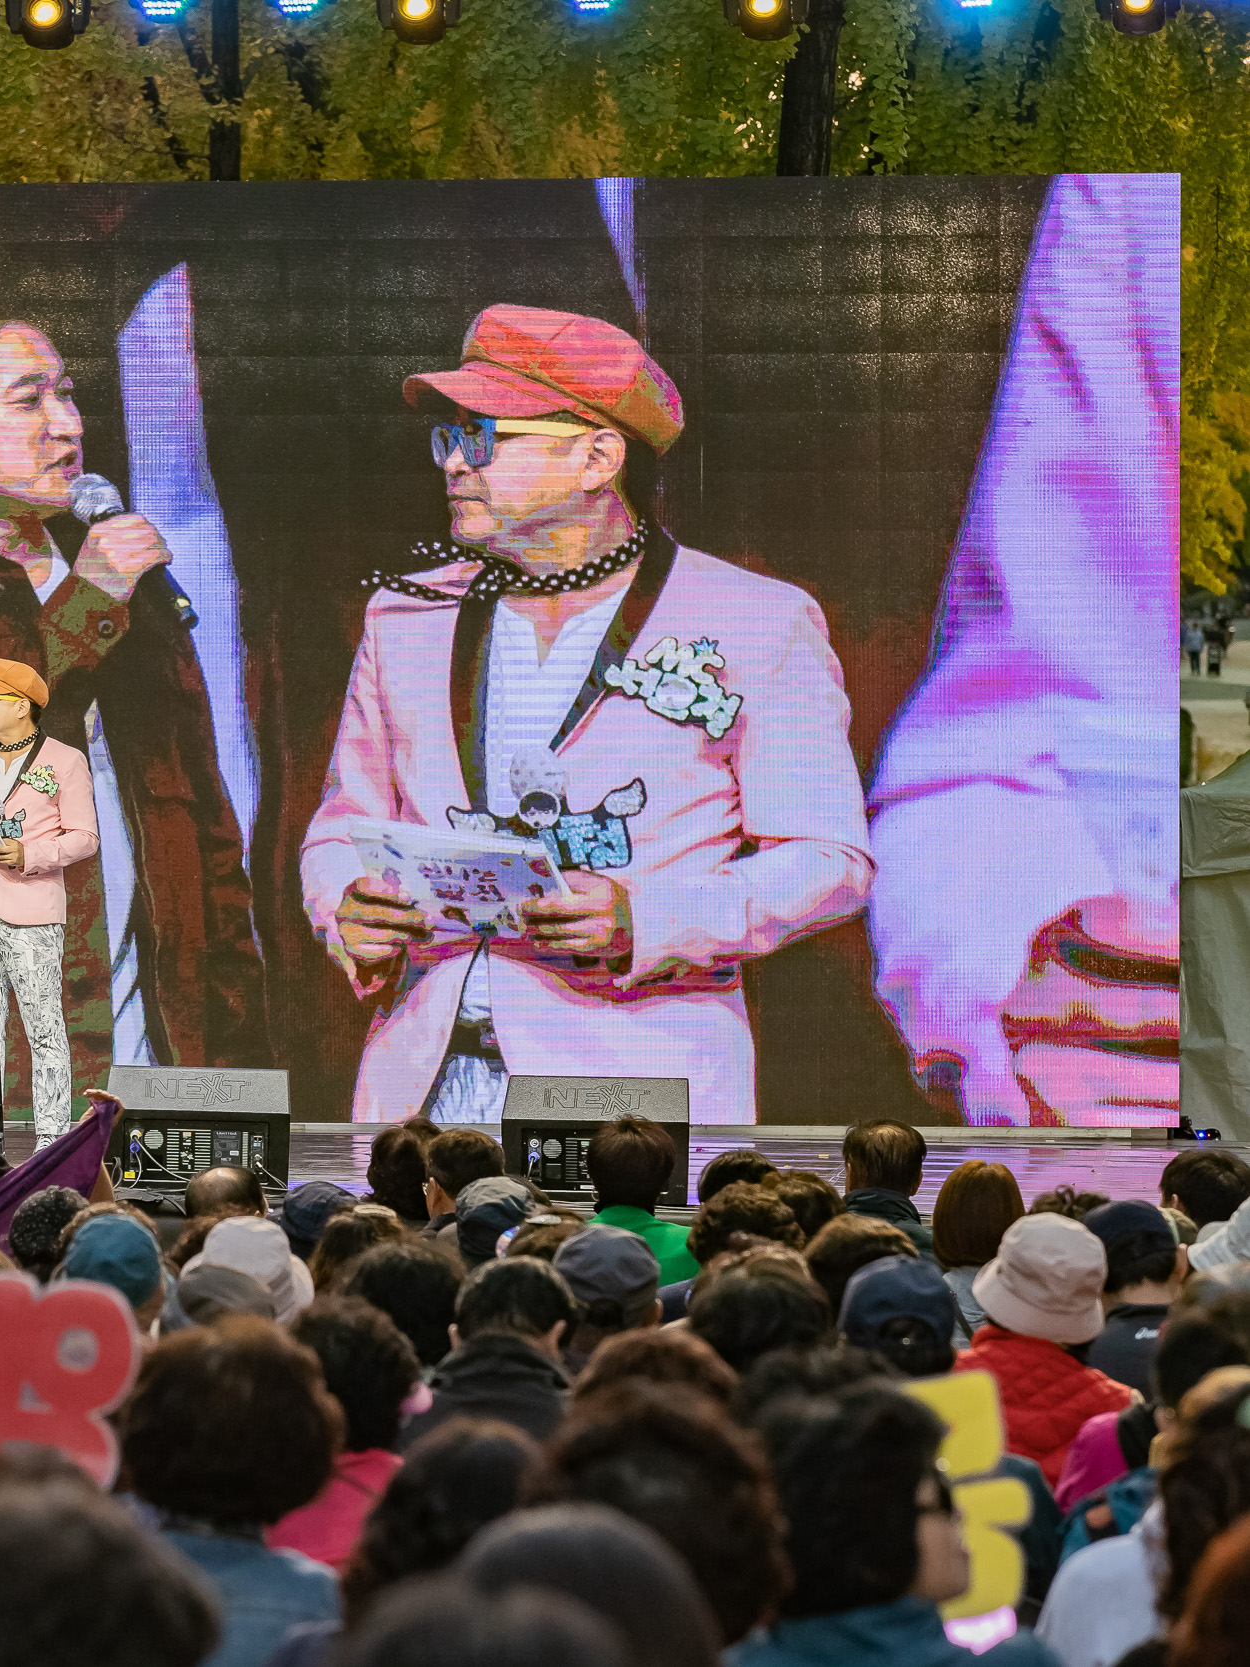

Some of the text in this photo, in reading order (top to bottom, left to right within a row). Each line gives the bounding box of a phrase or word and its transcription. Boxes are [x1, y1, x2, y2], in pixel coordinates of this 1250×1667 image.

[645, 637, 725, 684] MC
[32, 765, 55, 781] MC
[144, 1073, 248, 1106] NEXT
[543, 1082, 648, 1116] NEXT
